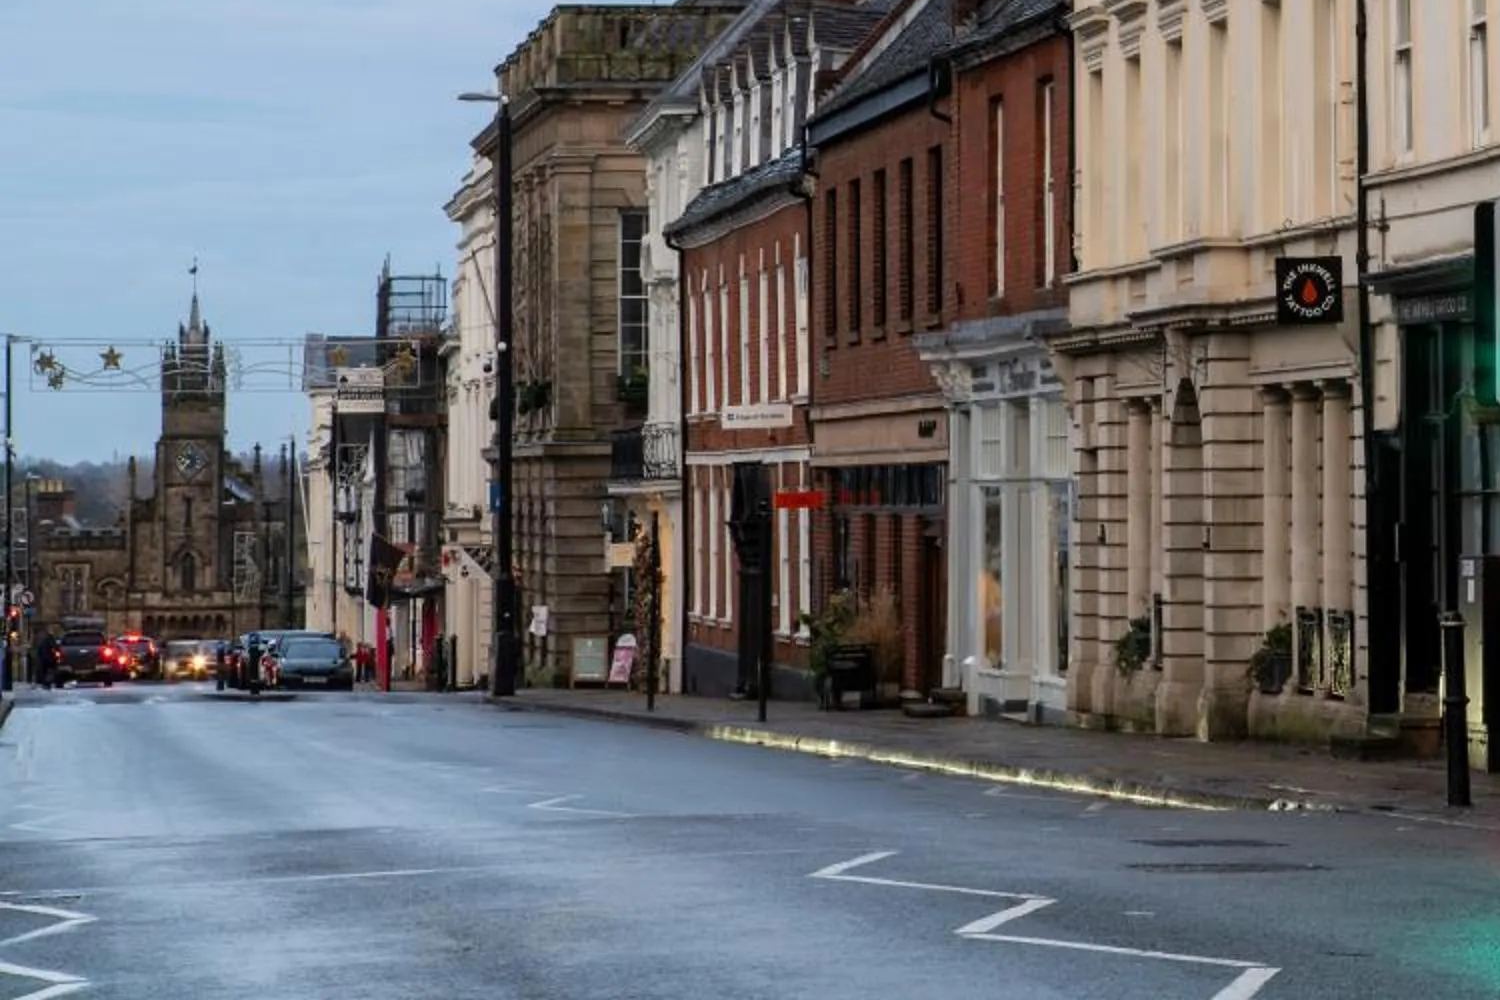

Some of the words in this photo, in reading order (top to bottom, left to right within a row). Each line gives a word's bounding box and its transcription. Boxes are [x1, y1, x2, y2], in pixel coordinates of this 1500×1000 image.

[1283, 271, 1297, 290] THE
[1298, 264, 1336, 291] INKWELL
[1285, 294, 1322, 318] TATTOO
